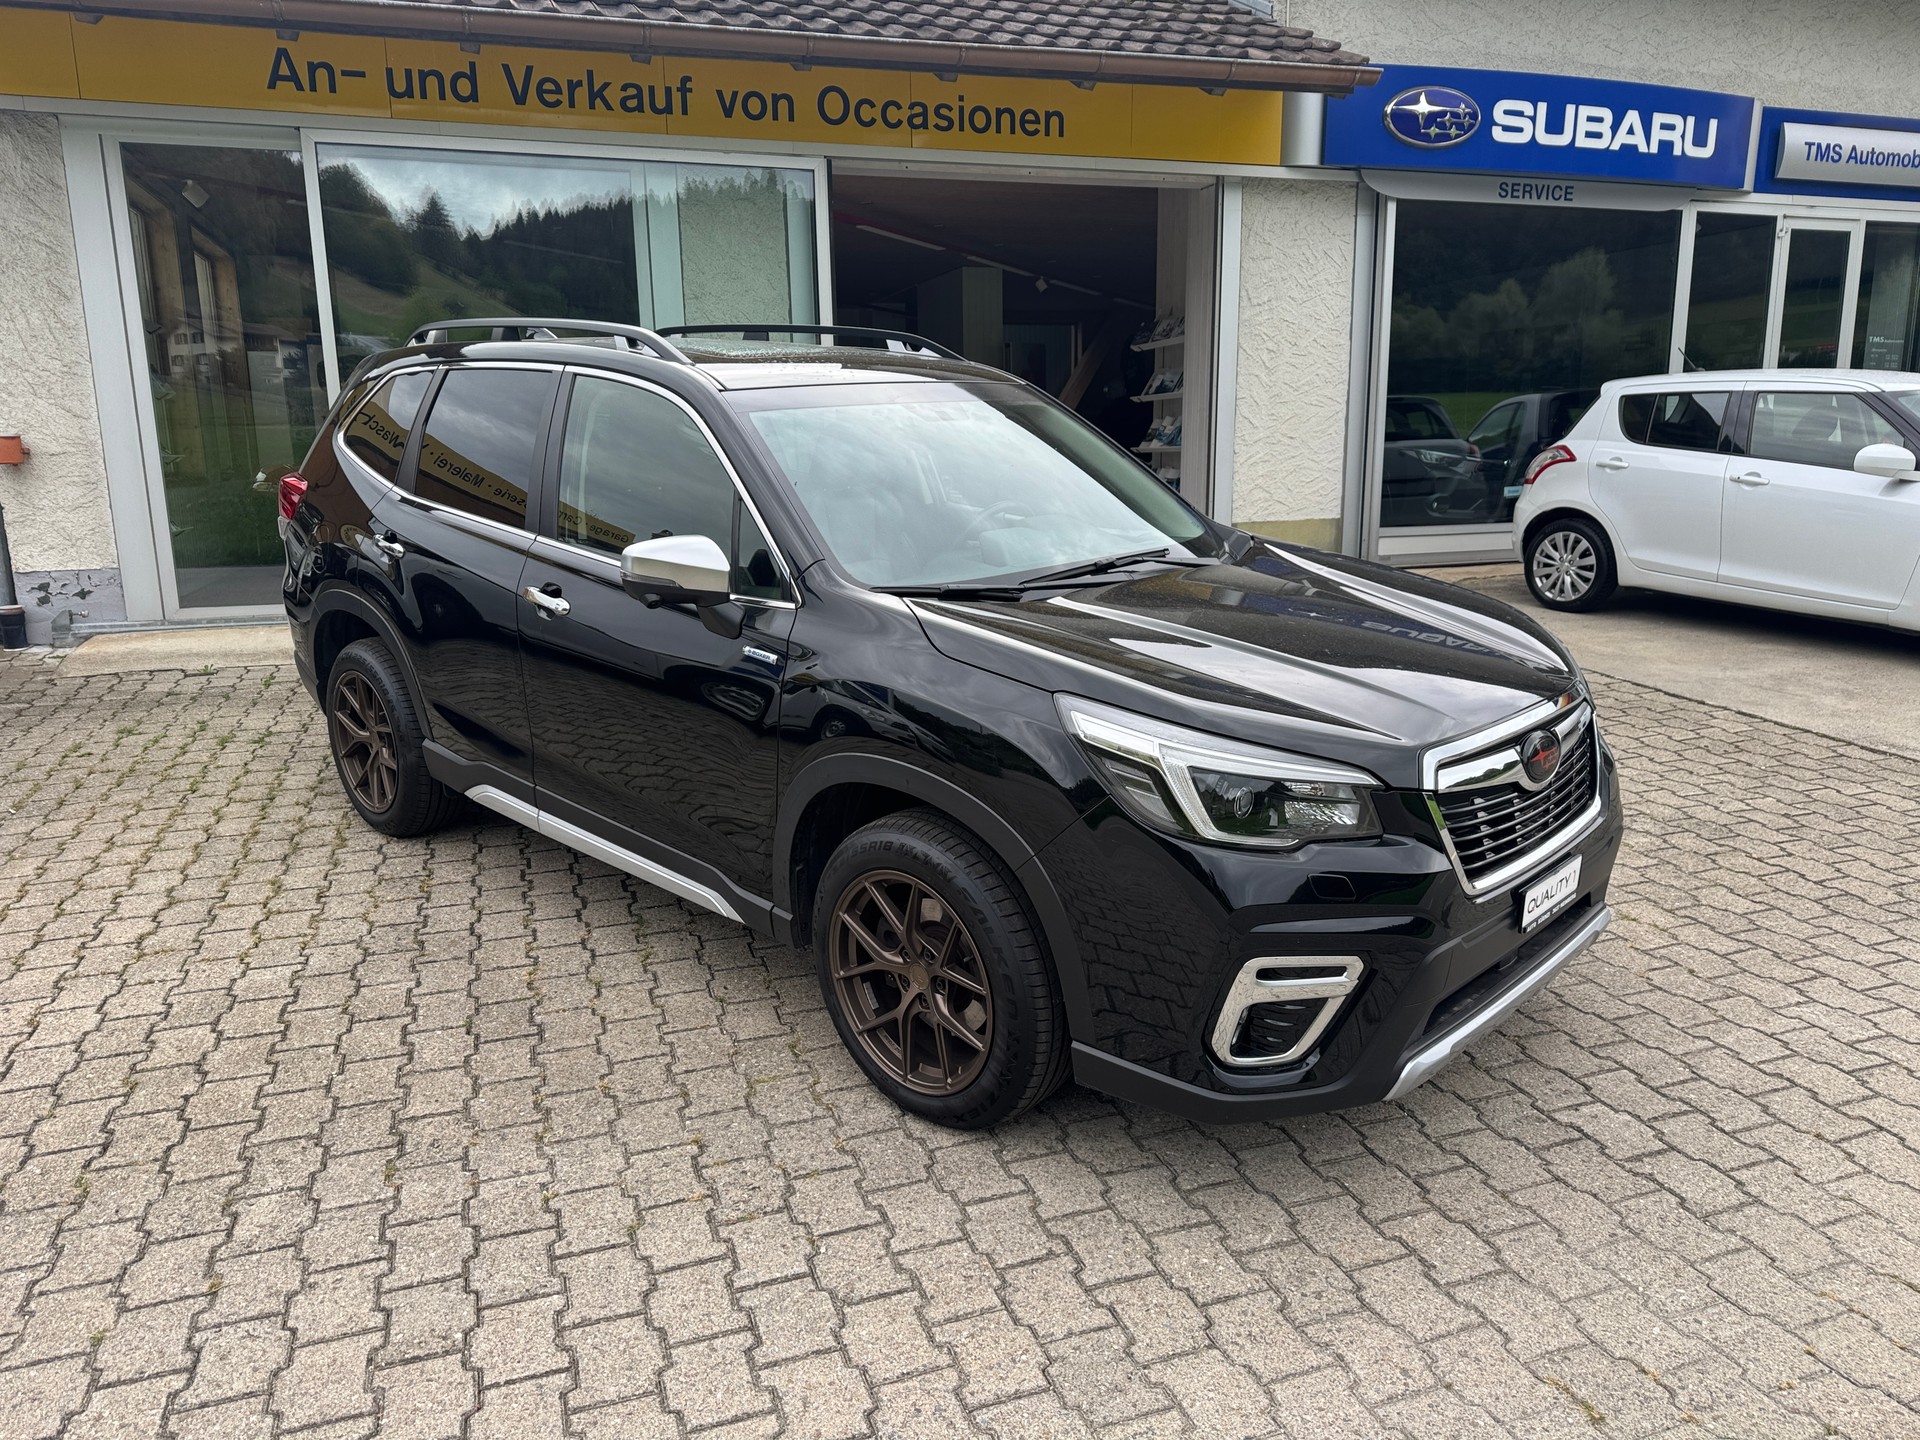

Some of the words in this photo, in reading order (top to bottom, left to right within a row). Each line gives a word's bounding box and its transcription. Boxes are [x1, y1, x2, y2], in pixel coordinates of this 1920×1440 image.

[267, 46, 366, 94] An-
[386, 61, 478, 104] und
[502, 63, 694, 116] Verkauf
[716, 90, 795, 122] von
[816, 85, 1065, 138] Occasionen
[1490, 98, 1719, 160] SUBARU
[1804, 141, 1843, 164] TMS
[1845, 144, 1920, 169] Automob
[1497, 181, 1575, 203] SERVICE
[1527, 872, 1572, 914] QUALITY
[1572, 869, 1577, 883] 1
